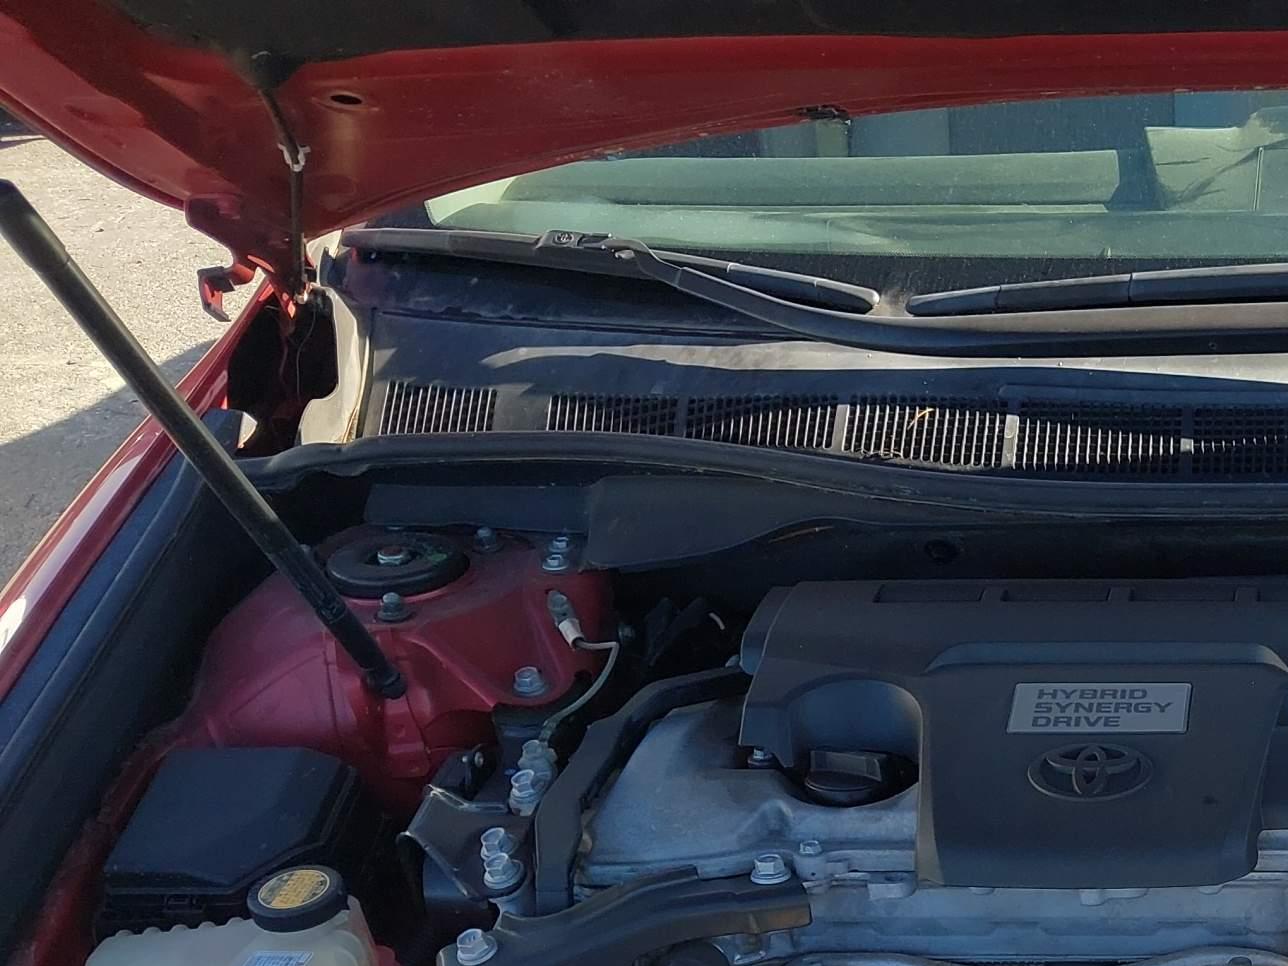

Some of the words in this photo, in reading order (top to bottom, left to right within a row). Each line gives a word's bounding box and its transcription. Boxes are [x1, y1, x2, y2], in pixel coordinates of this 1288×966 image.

[1036, 688, 1148, 700] HYBRID
[1033, 702, 1174, 714] SYNERGY
[1031, 716, 1121, 728] DRIVE
